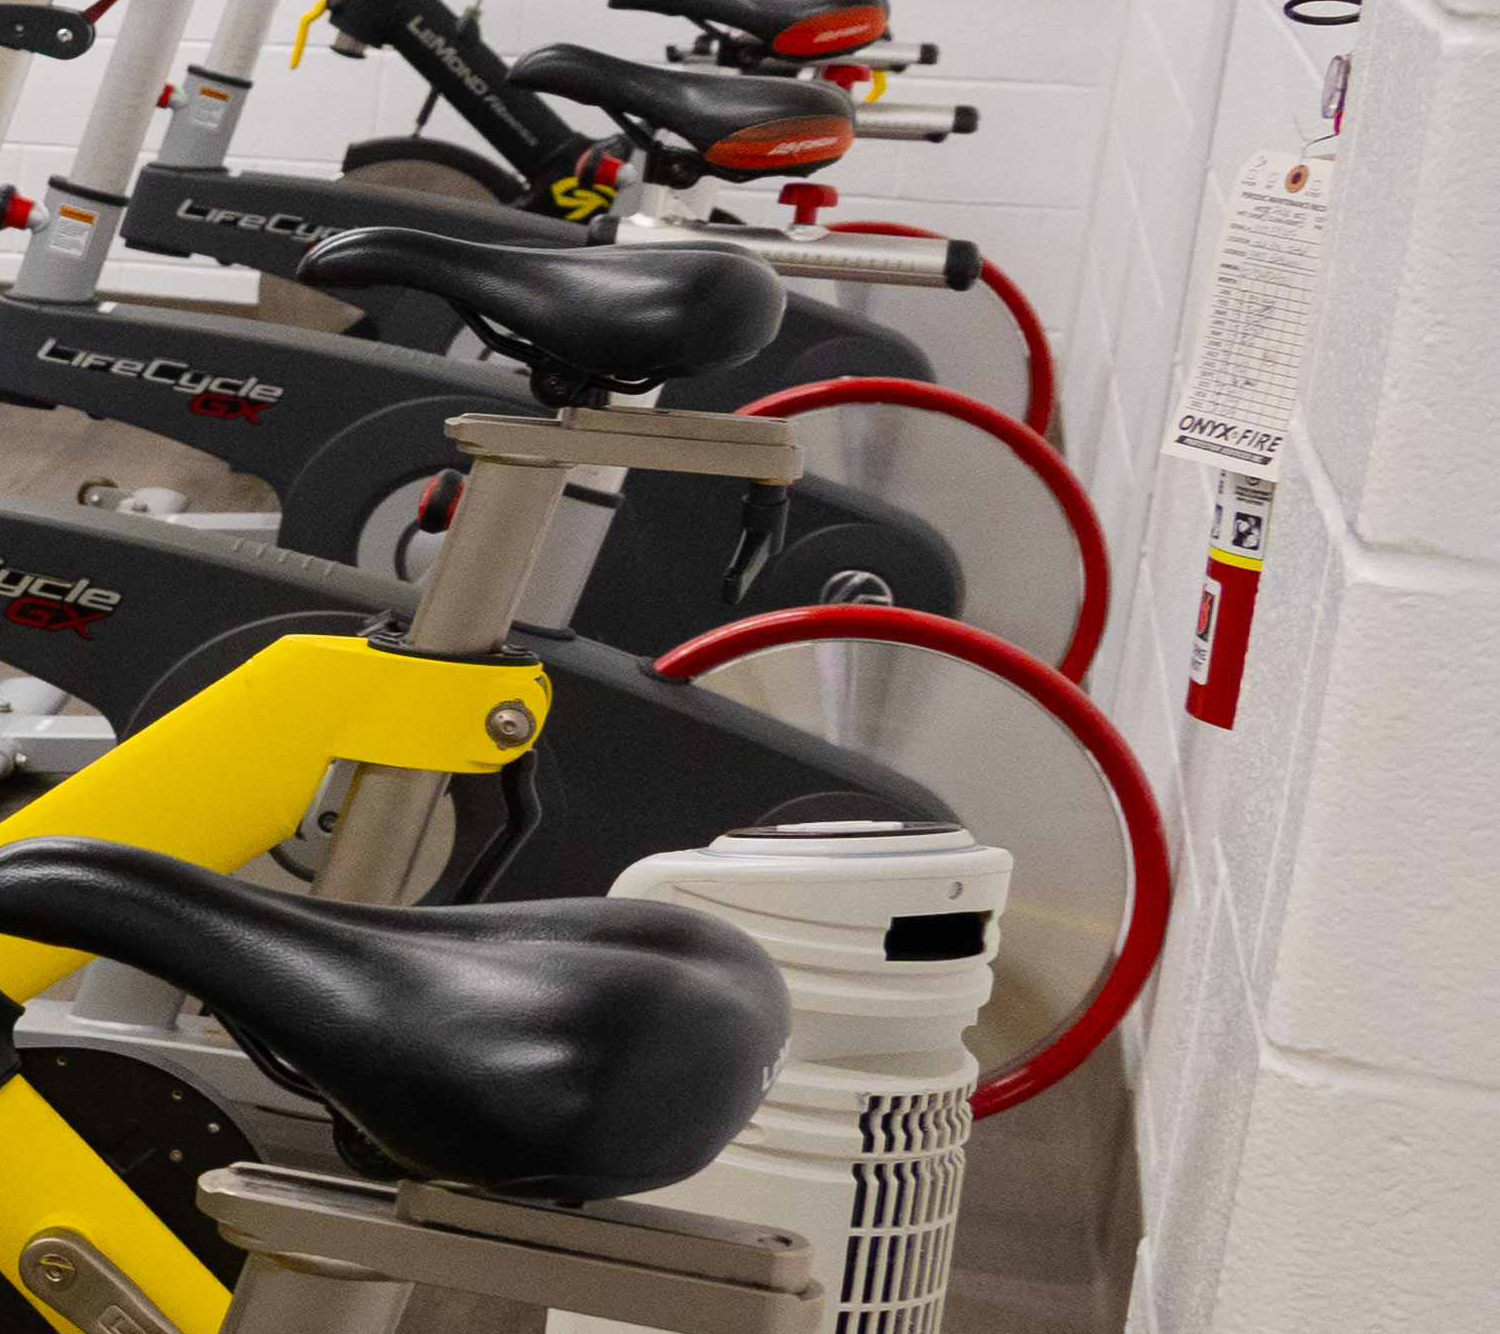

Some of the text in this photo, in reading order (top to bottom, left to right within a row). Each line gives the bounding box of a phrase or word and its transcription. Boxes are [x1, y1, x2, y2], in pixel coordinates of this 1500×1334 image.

[1178, 415, 1234, 442] ONYX
[1235, 429, 1284, 454] FIRE
[4, 595, 111, 641] GX
